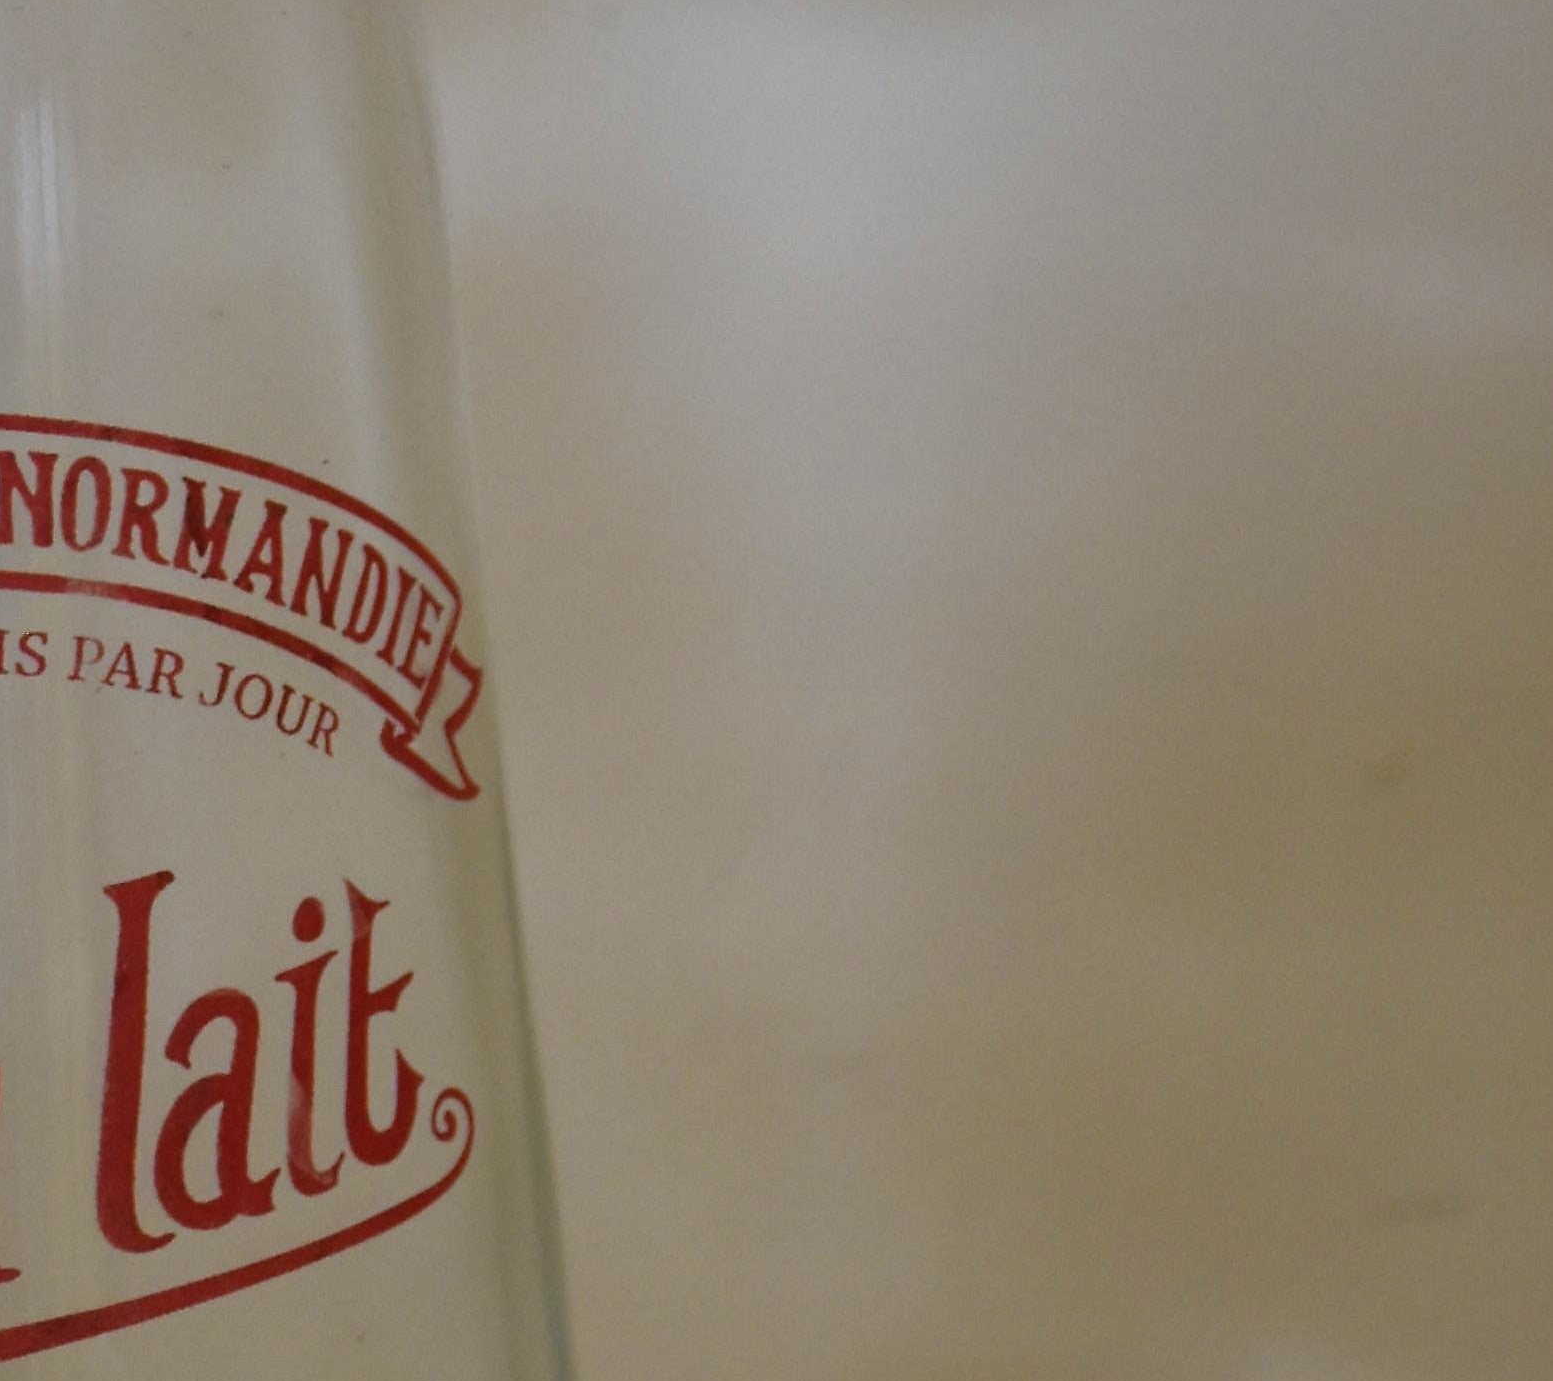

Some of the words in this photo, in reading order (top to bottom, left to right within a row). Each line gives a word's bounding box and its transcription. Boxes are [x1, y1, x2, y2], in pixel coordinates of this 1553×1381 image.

[67, 634, 186, 700] PAR
[197, 660, 342, 757] JOUR
[94, 869, 427, 1256] lait
